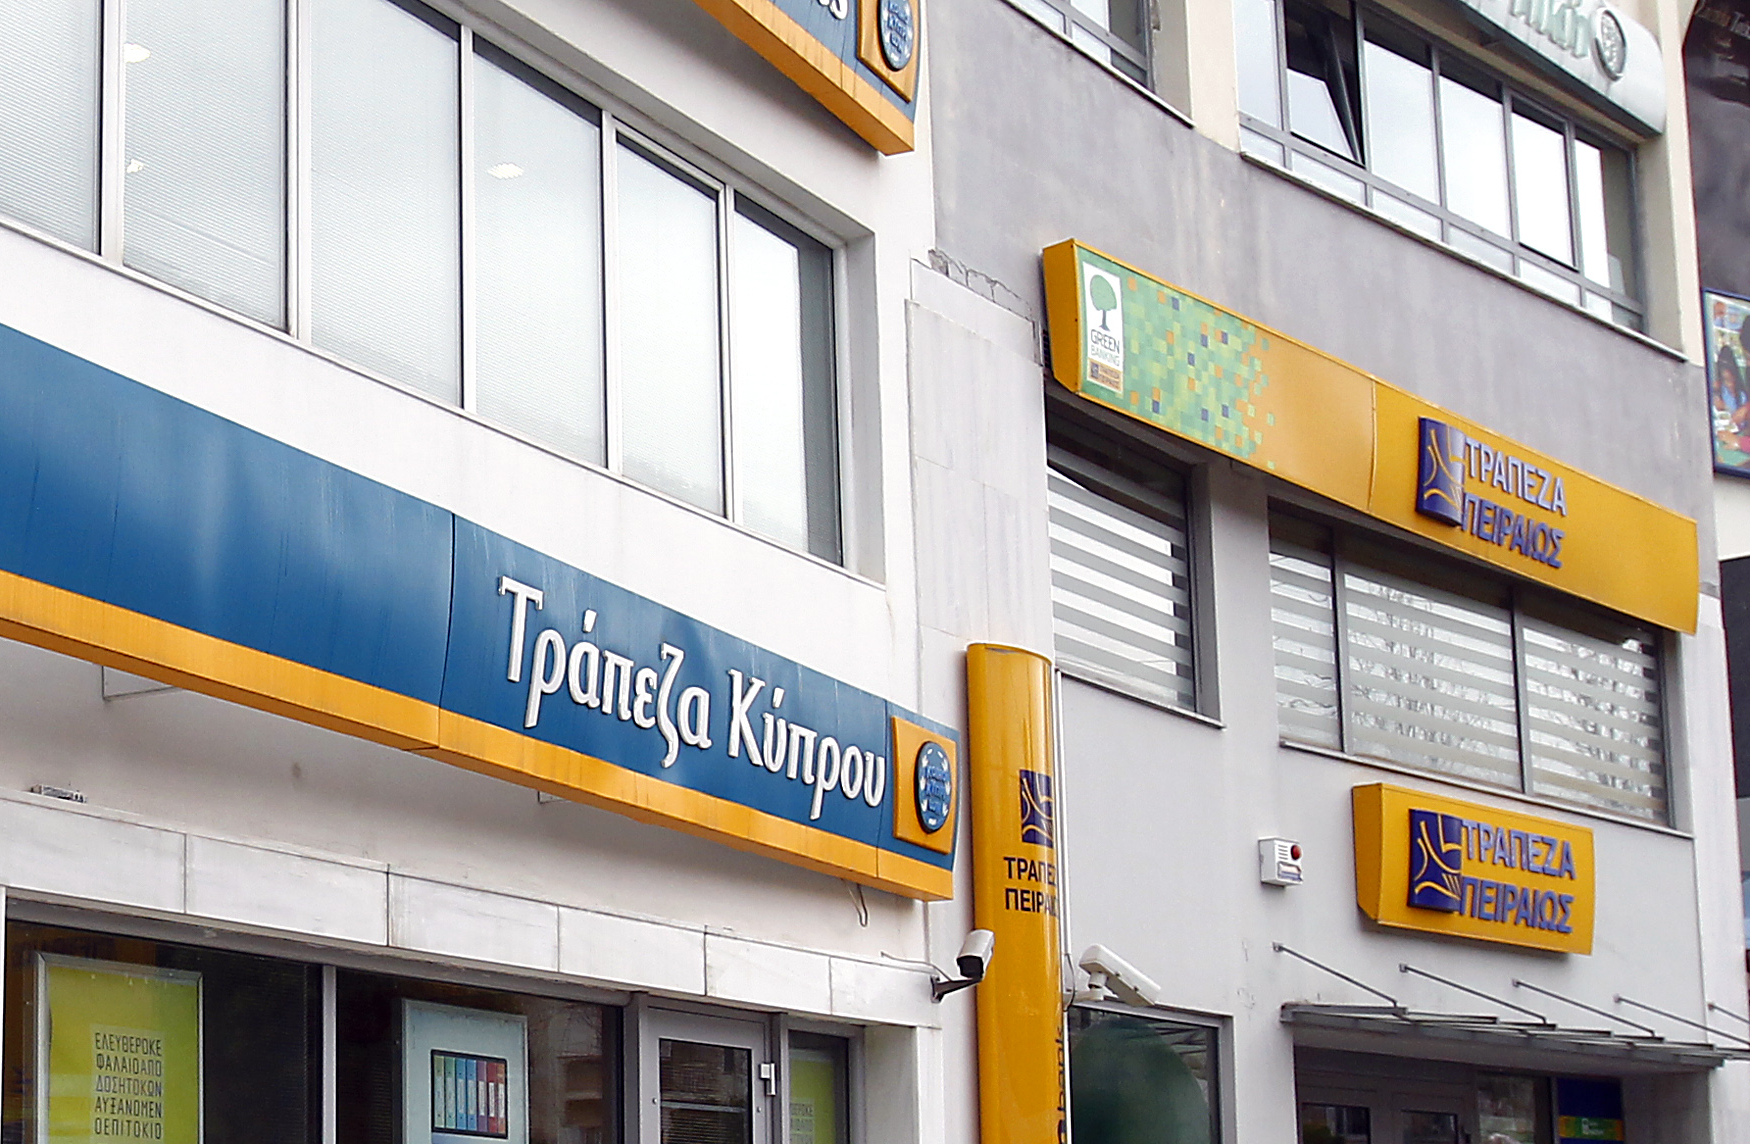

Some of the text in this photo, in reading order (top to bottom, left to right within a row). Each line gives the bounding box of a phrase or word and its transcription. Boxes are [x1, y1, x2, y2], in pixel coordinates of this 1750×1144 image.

[1090, 328, 1121, 355] GREEN
[1464, 436, 1568, 517] ΤΡΑΠΕΖΑ
[1460, 491, 1566, 569] ΠΕΙΡΑΙΩΣ
[498, 575, 887, 820] Τράπεζα Κύπρου
[1462, 818, 1577, 881] ΤΡΑΠΕΖΑ
[1459, 875, 1575, 934] ΠΕΙΡΑΙΩΣ
[95, 1032, 162, 1056] ΕΛΕΥΘΕΡΟΚΕ
[96, 1053, 162, 1077] ΦΑΛΑΙΟΑΠΟ
[95, 1074, 162, 1097] ΔΟΣΗΤΟΚΩΝ
[94, 1096, 162, 1118] ΑΥΞΑΝΟΜΕΝ
[94, 1117, 162, 1140] ΟΕΠΙΤΟΚΙΟ
